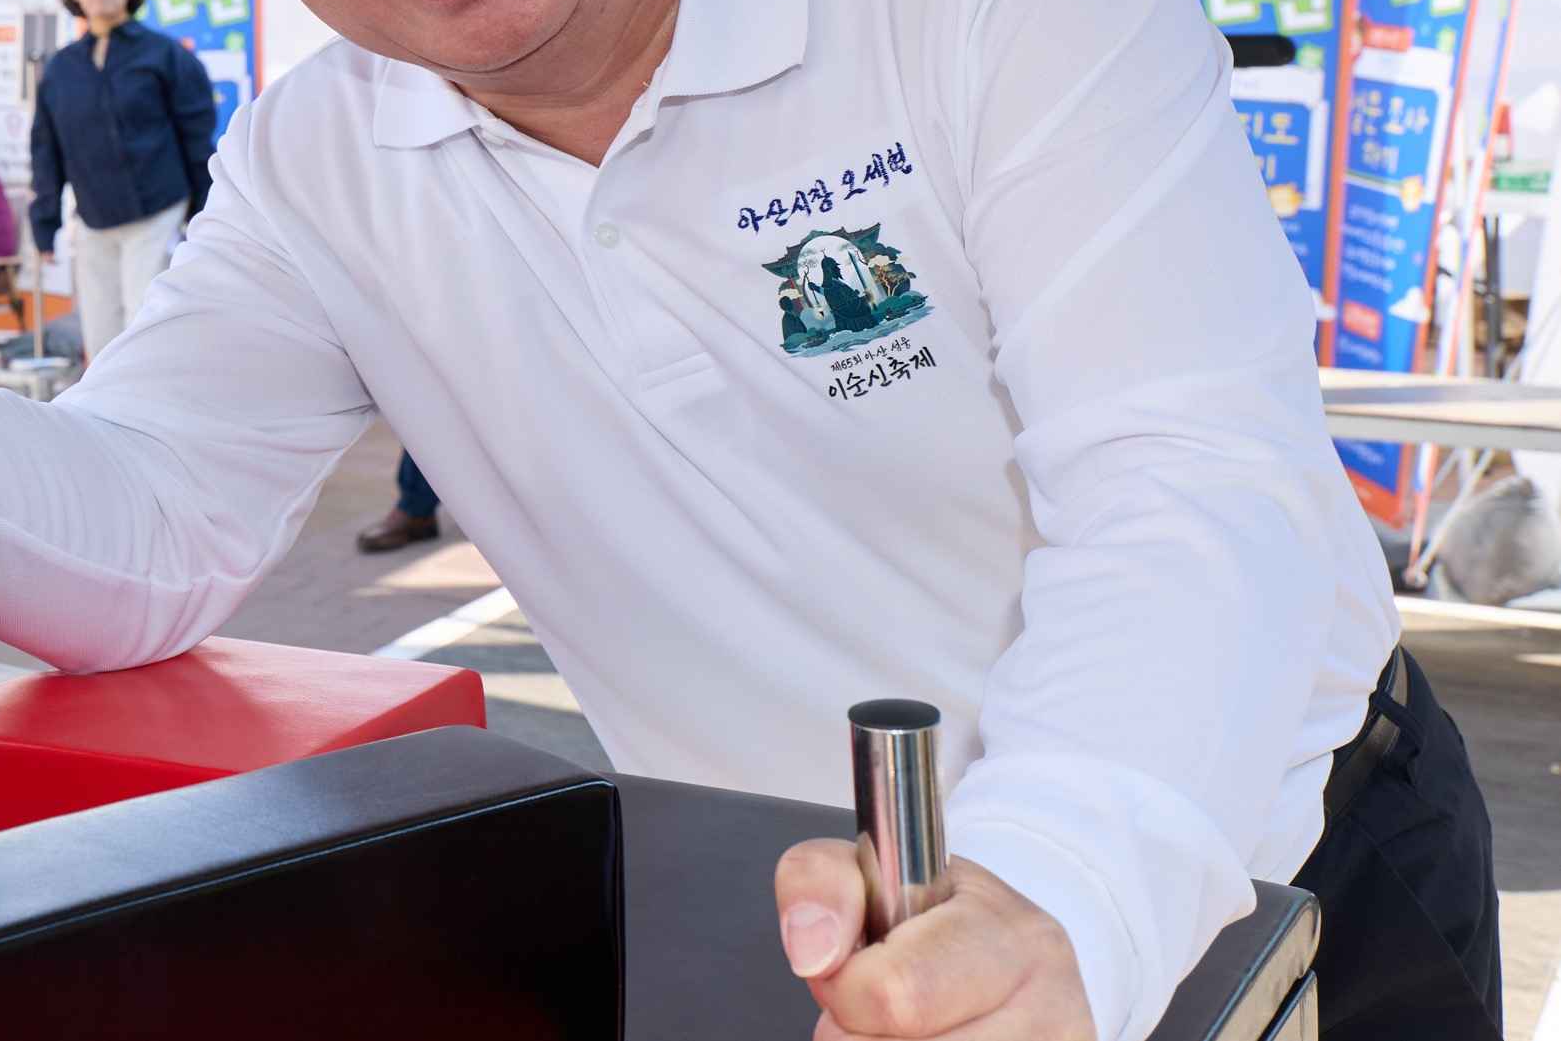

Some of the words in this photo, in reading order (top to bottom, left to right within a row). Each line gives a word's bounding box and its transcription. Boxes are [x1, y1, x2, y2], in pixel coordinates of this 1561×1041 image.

[737, 177, 834, 233] 아산시장
[841, 141, 913, 201] 오세현
[828, 346, 937, 400] 이순신축제
[831, 353, 863, 372] 제65회
